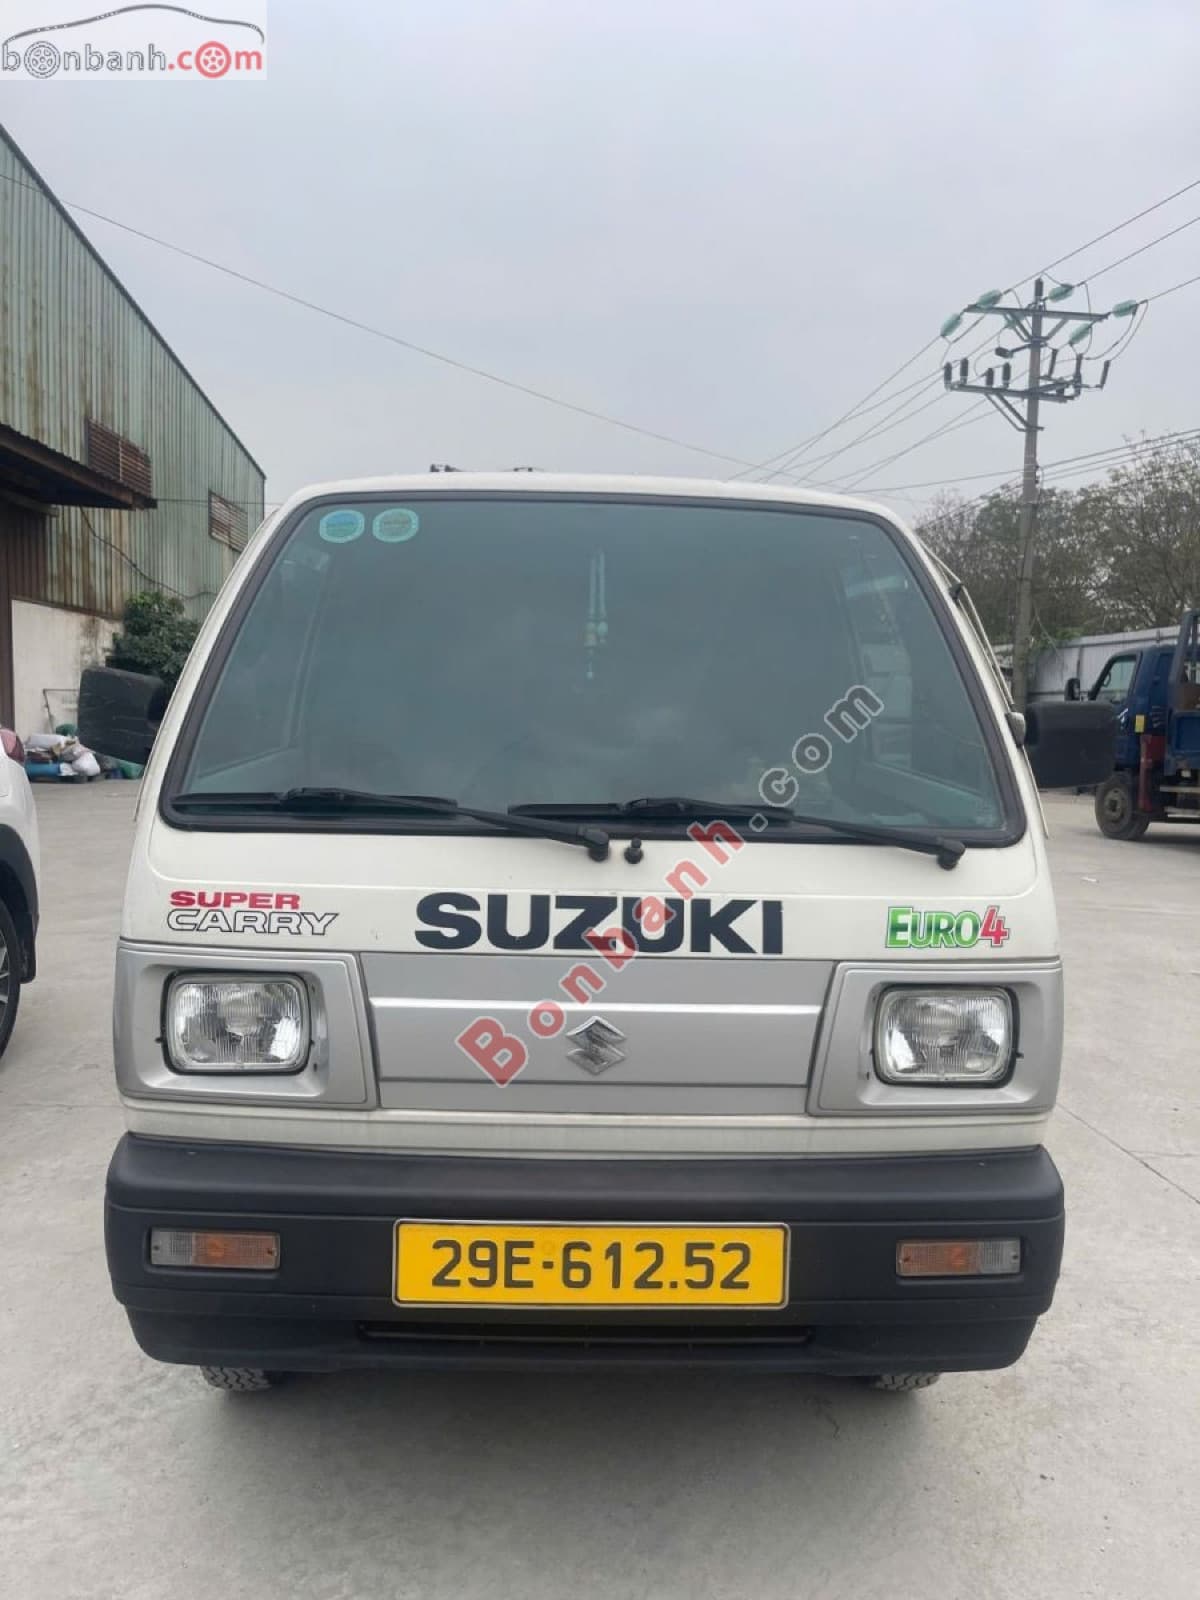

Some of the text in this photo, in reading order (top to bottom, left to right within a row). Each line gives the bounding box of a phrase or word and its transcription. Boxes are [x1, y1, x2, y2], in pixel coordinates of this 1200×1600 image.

[169, 890, 301, 910] SUPER
[167, 908, 339, 936] CARRY
[414, 892, 784, 955] SUZUKI
[431, 1239, 752, 1291] 29E-612.52
